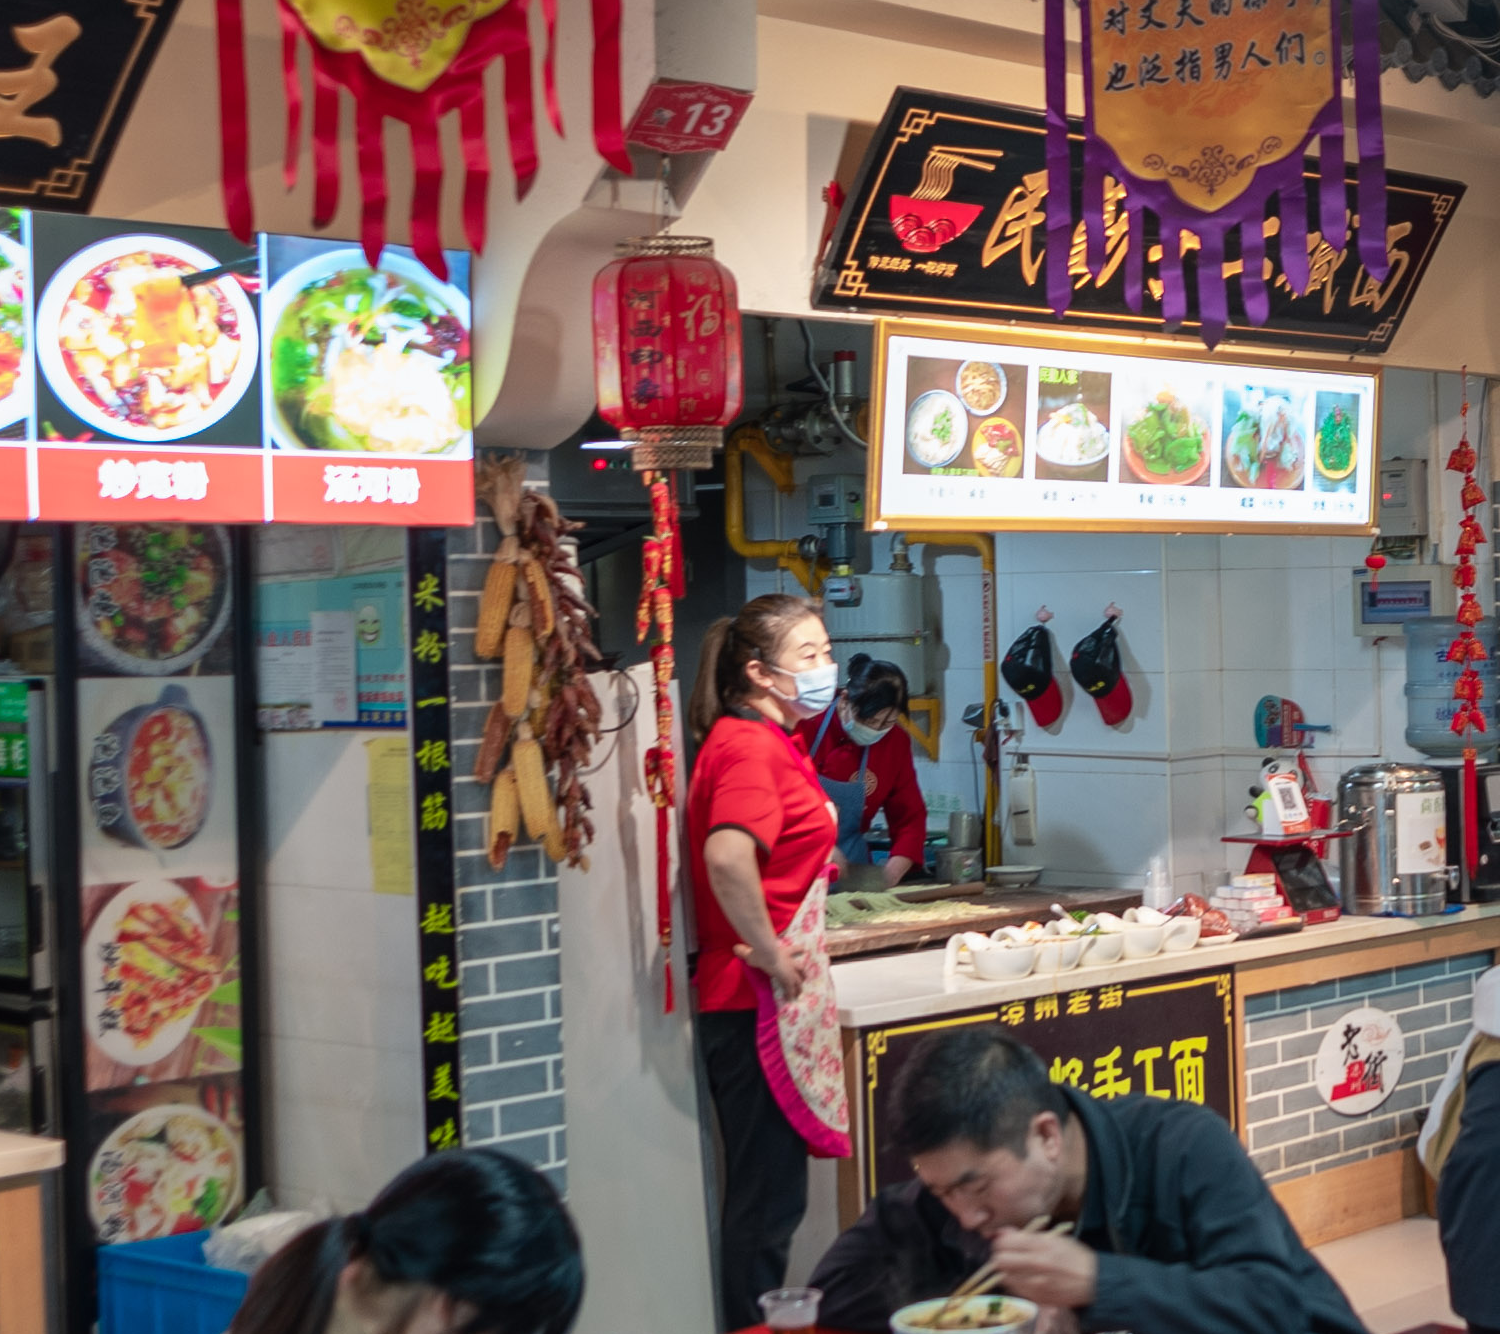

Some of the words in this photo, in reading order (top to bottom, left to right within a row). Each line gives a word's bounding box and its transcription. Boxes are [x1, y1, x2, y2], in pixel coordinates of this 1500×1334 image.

[682, 101, 734, 138] 13
[411, 572, 452, 833] 米粉一根筋
[419, 901, 461, 1152] 越吃越美味
[1000, 983, 1126, 1027] 凉州老街
